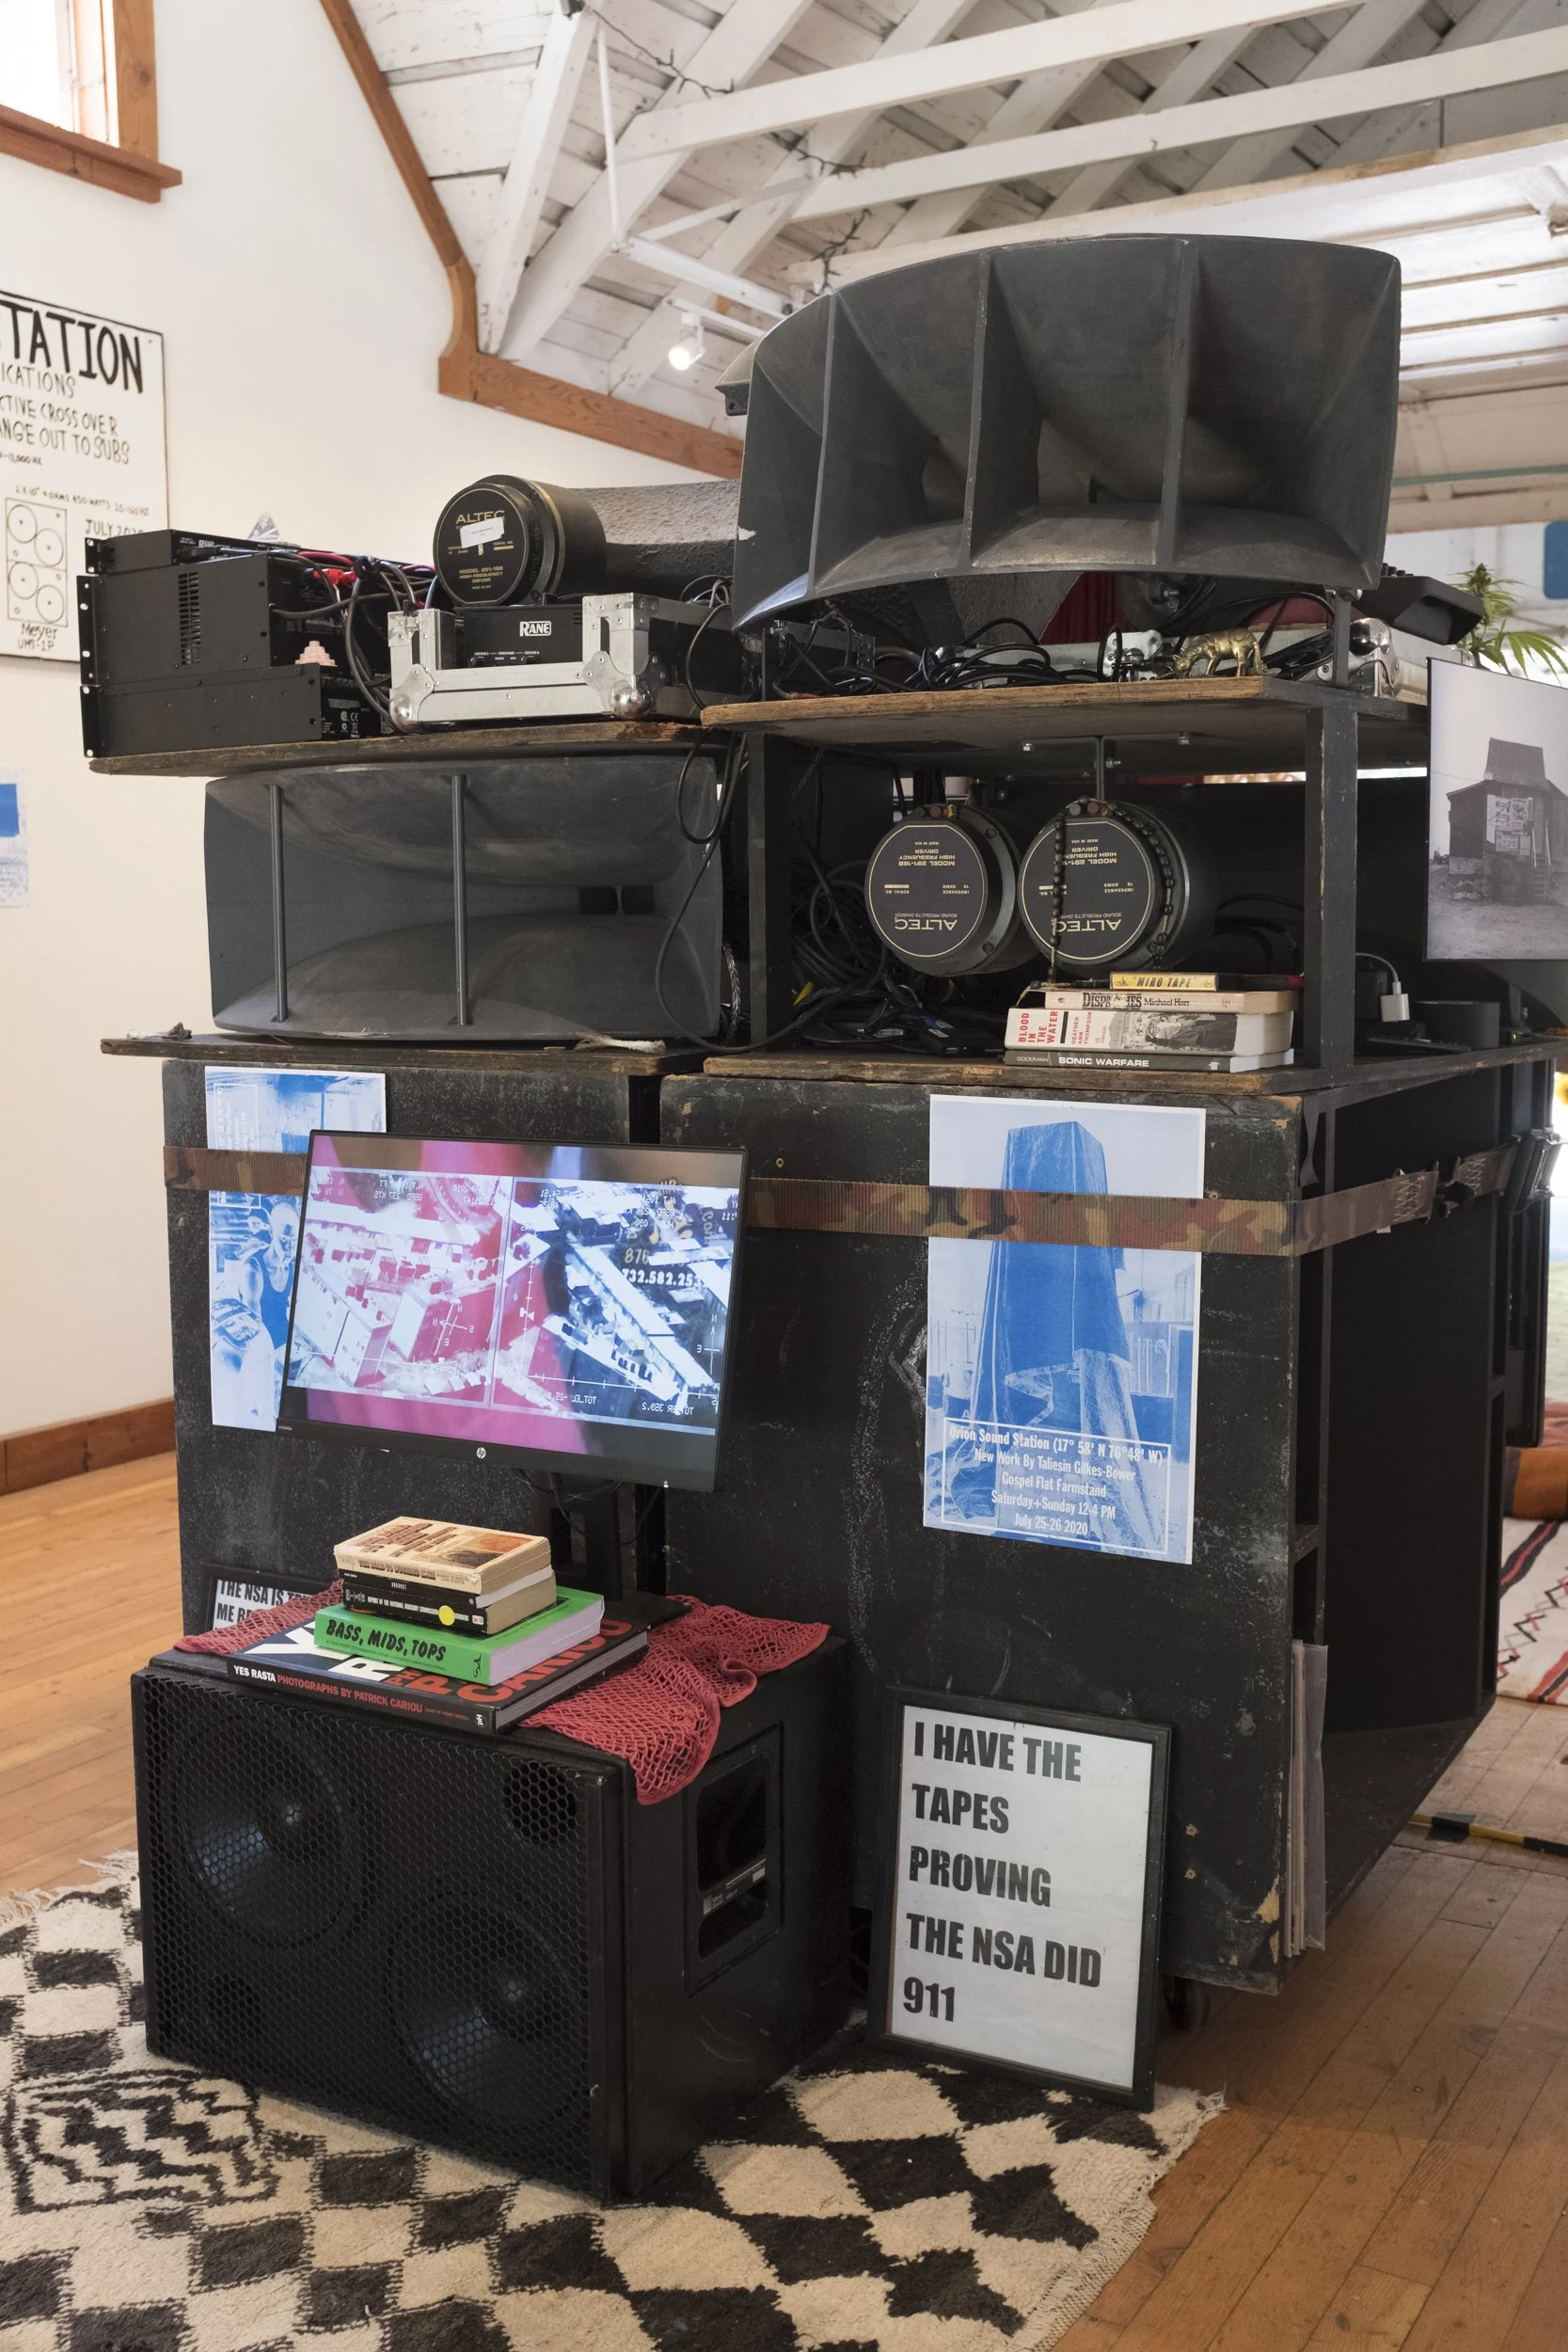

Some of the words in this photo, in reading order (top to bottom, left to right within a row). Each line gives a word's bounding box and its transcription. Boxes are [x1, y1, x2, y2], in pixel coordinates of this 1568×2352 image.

[40, 428, 66, 451] OUT
[72, 434, 90, 455] TO
[94, 437, 130, 465] SUBS
[85, 519, 113, 537] JULY
[455, 510, 505, 524] ALTEC
[21, 623, 59, 641] Meyer
[519, 621, 551, 637] RANE
[895, 919, 958, 930] ALTEC
[1144, 998, 1173, 1007] Michael
[1174, 997, 1190, 1007] Herr
[1018, 1012, 1030, 1042] BLOOD
[1027, 1033, 1037, 1043] IN
[1037, 1025, 1047, 1043] THE
[1046, 1010, 1059, 1043] WATER
[1071, 1016, 1080, 1044] HEATHER
[1084, 1011, 1092, 1044] THOMPSON
[1058, 1057, 1093, 1065] SONIC
[1096, 1058, 1149, 1068] WARFARE
[949, 1425, 976, 1440] Orion
[979, 1428, 1010, 1445] Sound
[1012, 1432, 1050, 1450] Station
[1078, 1440, 1095, 1456] 58'
[1098, 1442, 1105, 1457] N
[1148, 1449, 1164, 1468] W)
[974, 1448, 994, 1463] New
[996, 1450, 1021, 1466] Work
[1022, 1454, 1035, 1470] By
[1037, 1455, 1071, 1472] Taliesin
[1074, 1460, 1136, 1482] Gilkes-Bower
[1002, 1470, 1034, 1488] Gospel
[1036, 1474, 1053, 1491] Flat
[1056, 1478, 1106, 1498] Farmstand
[991, 1489, 1075, 1517] Saturday+Sunday
[1078, 1502, 1098, 1518] 12-4
[1101, 1504, 1116, 1520] PM
[1014, 1513, 1033, 1530] July
[1035, 1516, 1062, 1533] 25-26
[1064, 1518, 1088, 1536] 2020
[219, 1581, 242, 1598] THE
[245, 1582, 269, 1605] NSA
[271, 1587, 284, 1606] IS
[216, 1602, 235, 1623] ME
[325, 1619, 363, 1646] BASS,
[367, 1629, 407, 1657] MIDS,
[411, 1639, 446, 1661] TOPS
[233, 1664, 249, 1677] YES
[250, 1669, 276, 1682] RASTA
[277, 1675, 339, 1695] PHOTOGRAPHS
[341, 1687, 352, 1698] BY
[354, 1691, 388, 1706] PATRICK
[390, 1698, 422, 1712] CARIOU
[914, 1721, 924, 1756] I
[934, 1724, 1014, 1771] HAVE
[1022, 1736, 1082, 1783] THE
[911, 1783, 1009, 1835] TAPES
[909, 1845, 1052, 1908] PROVING
[906, 1912, 963, 1960] THE
[972, 1926, 1036, 1976] NSA
[1044, 1940, 1101, 1988] DID
[903, 1976, 955, 2022] 911
